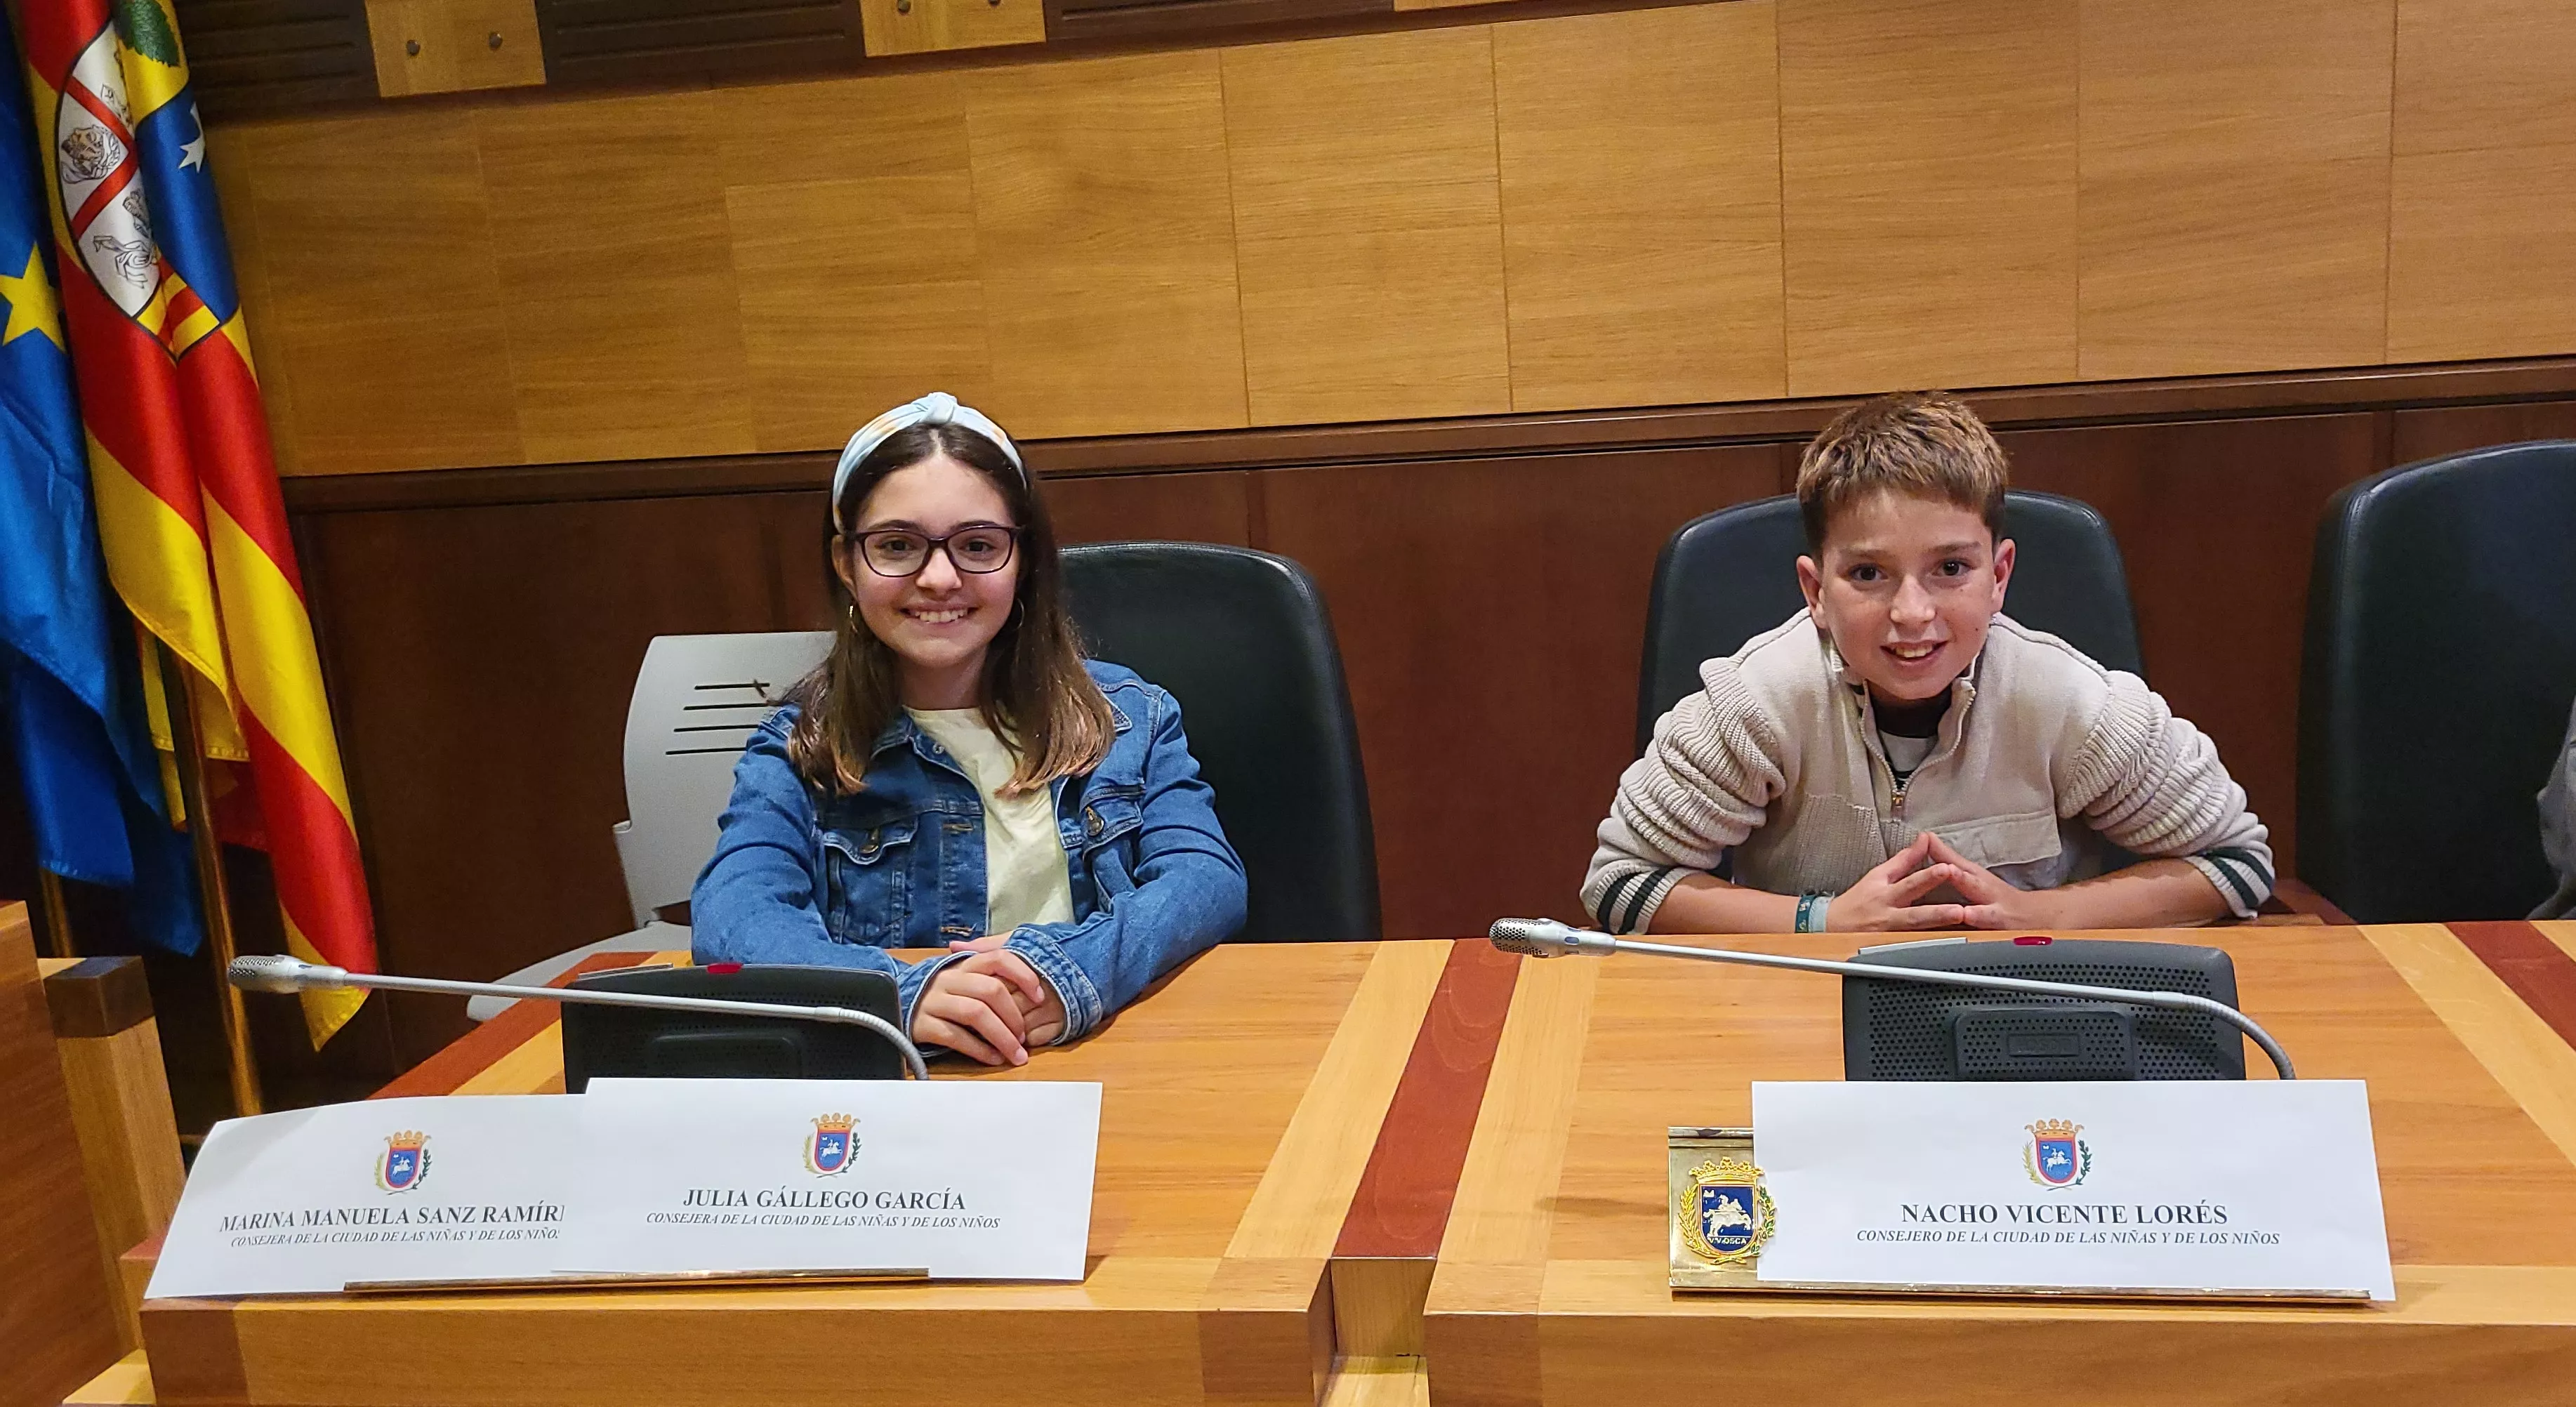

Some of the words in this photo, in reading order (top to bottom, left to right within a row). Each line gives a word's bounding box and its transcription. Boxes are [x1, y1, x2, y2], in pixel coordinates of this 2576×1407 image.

[683, 1189, 748, 1207] JULIA
[757, 1185, 868, 1209] GÁLLEGO
[876, 1187, 966, 1210] GARCÍA
[219, 1211, 295, 1233] MARINA
[300, 1207, 410, 1227] MANUELA
[416, 1206, 477, 1224] SANZ
[481, 1200, 564, 1223] RAMÍR
[647, 1213, 719, 1224] CONSEJERA
[721, 1214, 740, 1224] DE
[741, 1214, 758, 1225] LA
[761, 1214, 810, 1226] CIUDAD
[811, 1215, 831, 1226] DE
[832, 1215, 857, 1227] LAS
[859, 1214, 899, 1227] NIÑAS
[901, 1216, 911, 1227] Y
[911, 1217, 930, 1227] DE
[932, 1217, 958, 1228] LOS
[959, 1215, 1001, 1229] NIÑOS
[1900, 1204, 1998, 1224] NACHO
[2005, 1205, 2128, 1224] VICENTE
[2135, 1199, 2228, 1224] LORÉS
[231, 1234, 293, 1248] CONSEJERA
[295, 1233, 312, 1244] DE
[312, 1232, 329, 1243] LA
[332, 1231, 379, 1243] CIUDAD
[381, 1231, 399, 1242] DE
[400, 1231, 425, 1242] LAS
[426, 1228, 467, 1241] NIÑAS
[468, 1230, 477, 1241] Y
[478, 1230, 497, 1241] DE
[498, 1229, 523, 1241] LOS
[524, 1227, 560, 1240] NIÑO
[1857, 1230, 1943, 1242] CONSEJERO
[1946, 1231, 1967, 1242] DE
[1970, 1231, 1988, 1243] LA
[1993, 1231, 2050, 1243] CIUDAD
[2054, 1231, 2075, 1243] DE
[2079, 1231, 2107, 1243] LAS
[2110, 1229, 2158, 1244] NIÑAS
[2162, 1232, 2171, 1243] Y
[2174, 1232, 2195, 1244] DE
[2199, 1232, 2228, 1244] LOS
[2231, 1230, 2280, 1245] NIÑOS
